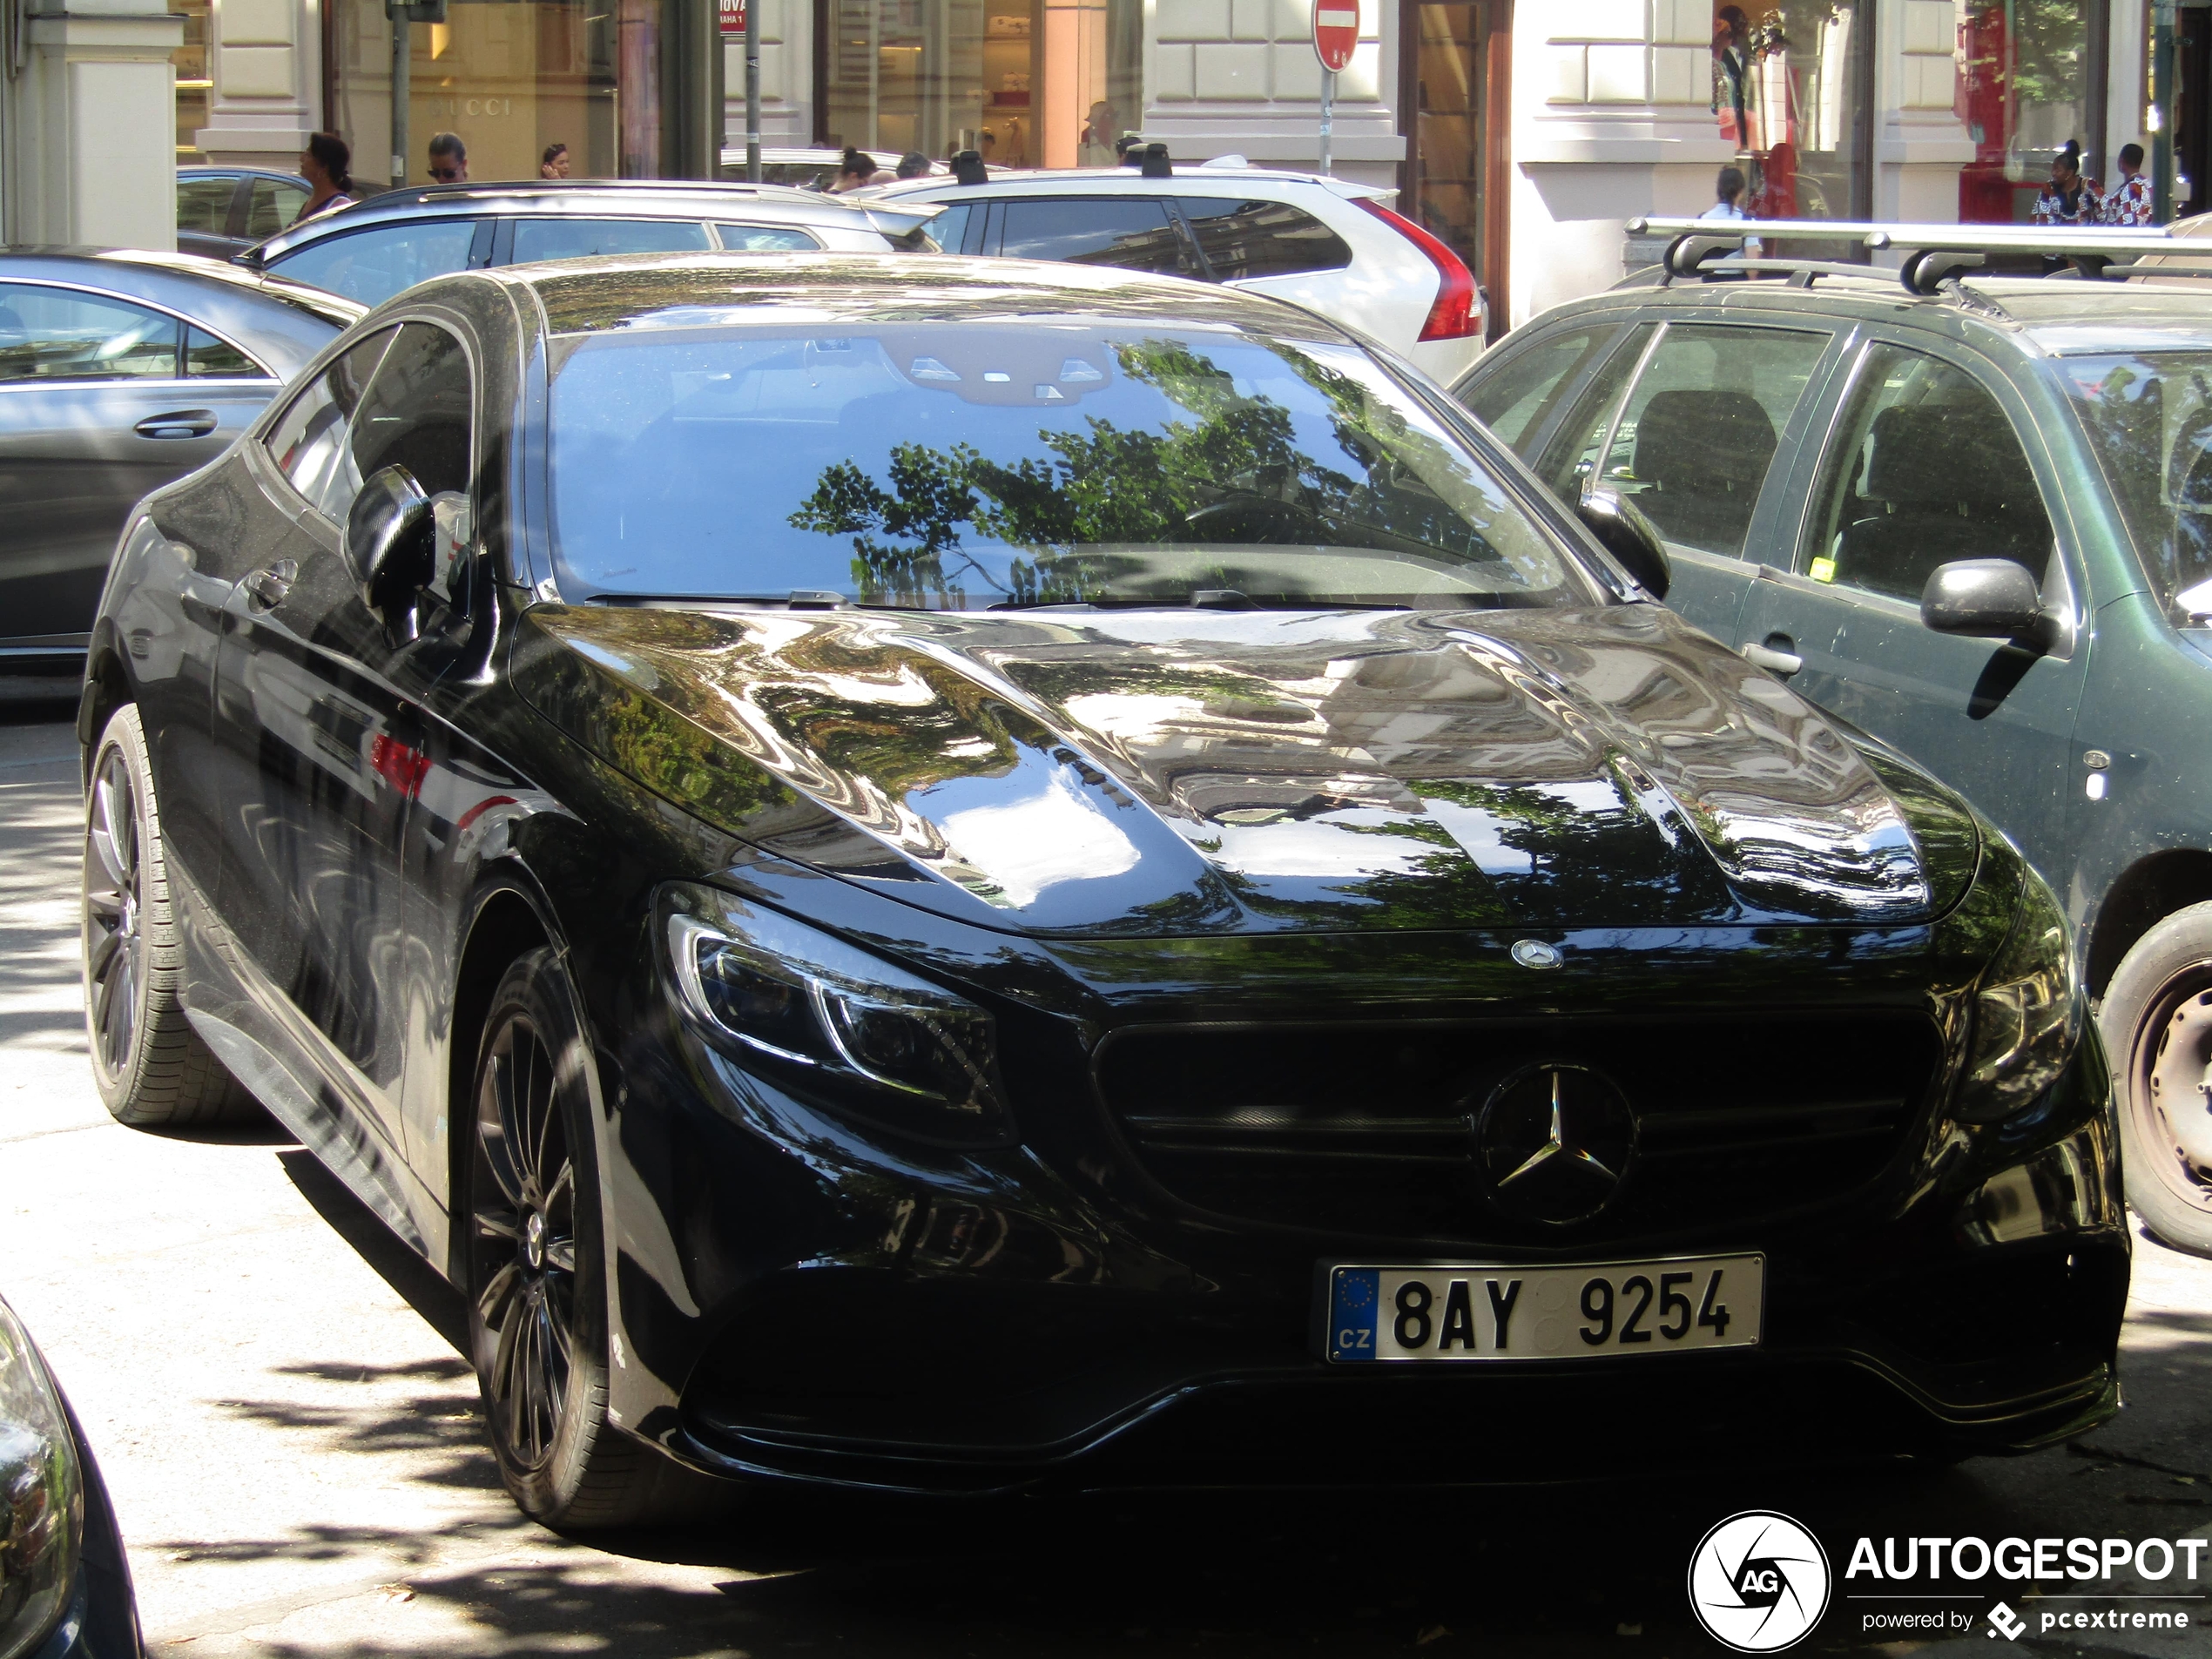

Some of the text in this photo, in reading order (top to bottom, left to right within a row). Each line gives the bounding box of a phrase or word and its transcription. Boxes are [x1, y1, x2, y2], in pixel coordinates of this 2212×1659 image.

[1339, 1270, 1730, 1349] CZ 8AY 9254
